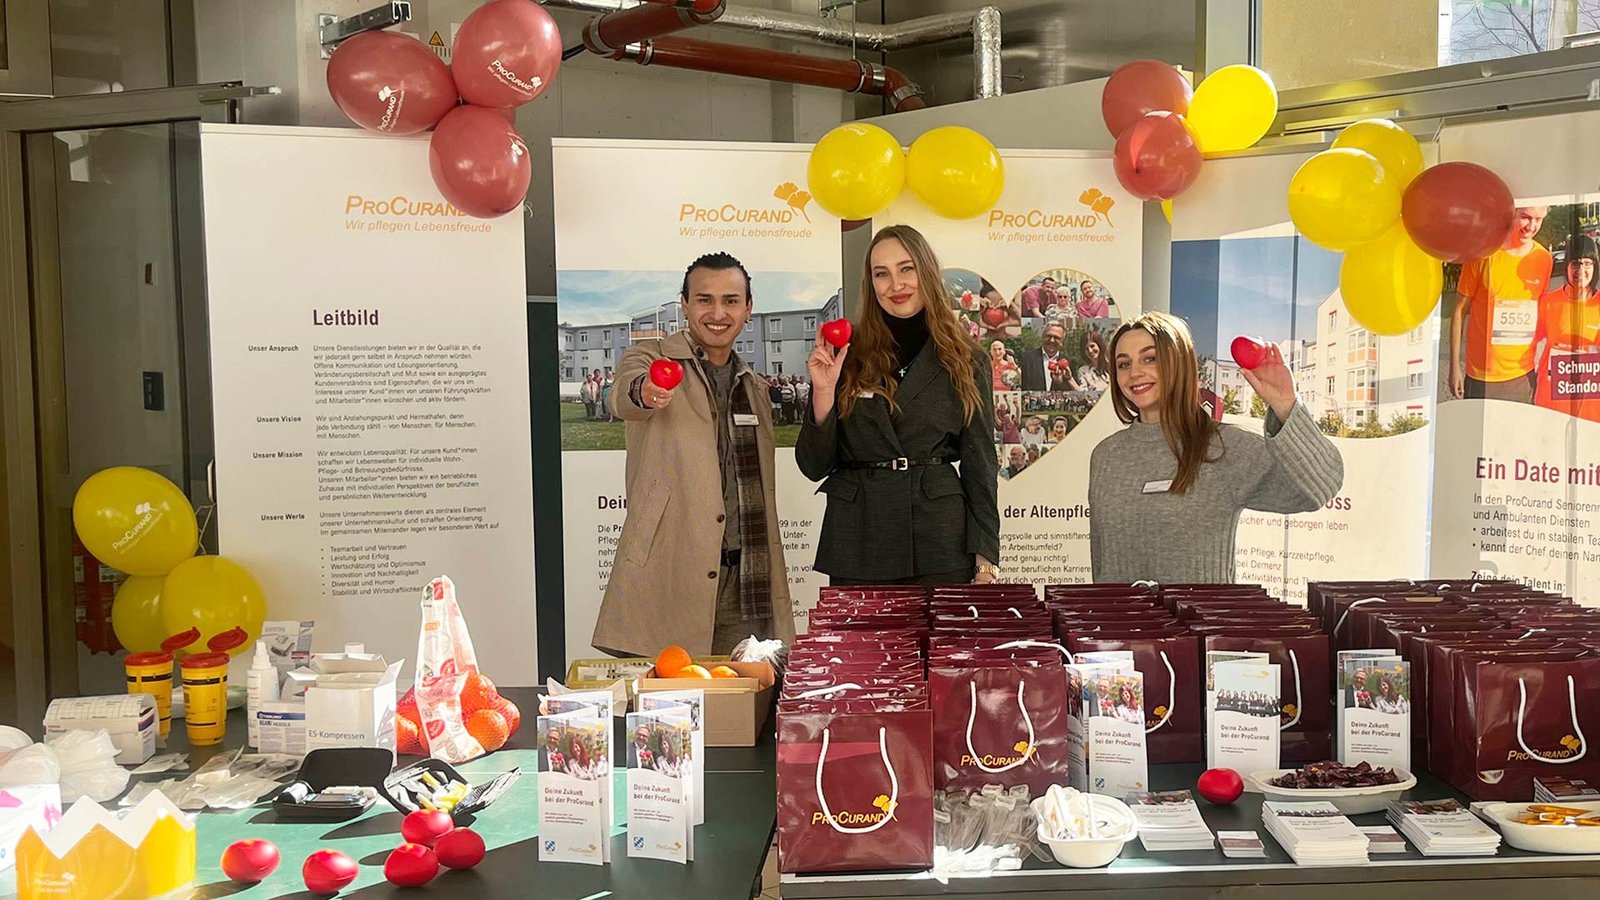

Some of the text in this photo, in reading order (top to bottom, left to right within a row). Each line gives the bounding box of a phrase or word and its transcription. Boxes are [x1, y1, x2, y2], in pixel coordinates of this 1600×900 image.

[345, 220, 492, 233] Wir pflegen Lebensfreude
[679, 227, 812, 239] Wir pflegen Lebensfreude
[988, 231, 1115, 243] Wir pflegen Lebensfreude
[313, 309, 379, 326] Leitbild
[1500, 312, 1532, 326] 5552
[268, 344, 299, 352] Anspruch
[1476, 457, 1506, 480] Ein
[1515, 459, 1560, 483] Date
[1474, 493, 1482, 503] In
[1485, 494, 1503, 505] den
[1505, 495, 1553, 509] ProCurand
[1004, 505, 1026, 518] der
[799, 519, 812, 527] der
[1238, 516, 1349, 531] sicher und geborgen leben
[1473, 511, 1590, 528] und Ambulanten Diensten
[598, 525, 611, 533] Die
[784, 531, 807, 540] Unter-
[1034, 532, 1048, 540] und
[1480, 526, 1521, 539] arbeitest
[1523, 529, 1534, 540] du
[1537, 530, 1546, 540] in
[1548, 532, 1584, 544] stabilen
[1008, 543, 1063, 551] Arbeitsumfeld?
[1480, 541, 1506, 552] kennt
[1508, 544, 1523, 554] der
[1525, 544, 1547, 556] Chef
[1549, 547, 1579, 560] deinen
[1020, 556, 1042, 564] genau
[1250, 560, 1282, 571] Demenz
[1021, 565, 1062, 573] beruflichen
[1241, 572, 1282, 583] Aktivitäten
[1283, 575, 1300, 585] und
[308, 730, 365, 740] ES-Kompressen
[1111, 730, 1131, 738] Zukunft
[562, 789, 583, 797] Zukunft
[651, 785, 671, 793] Zukunft
